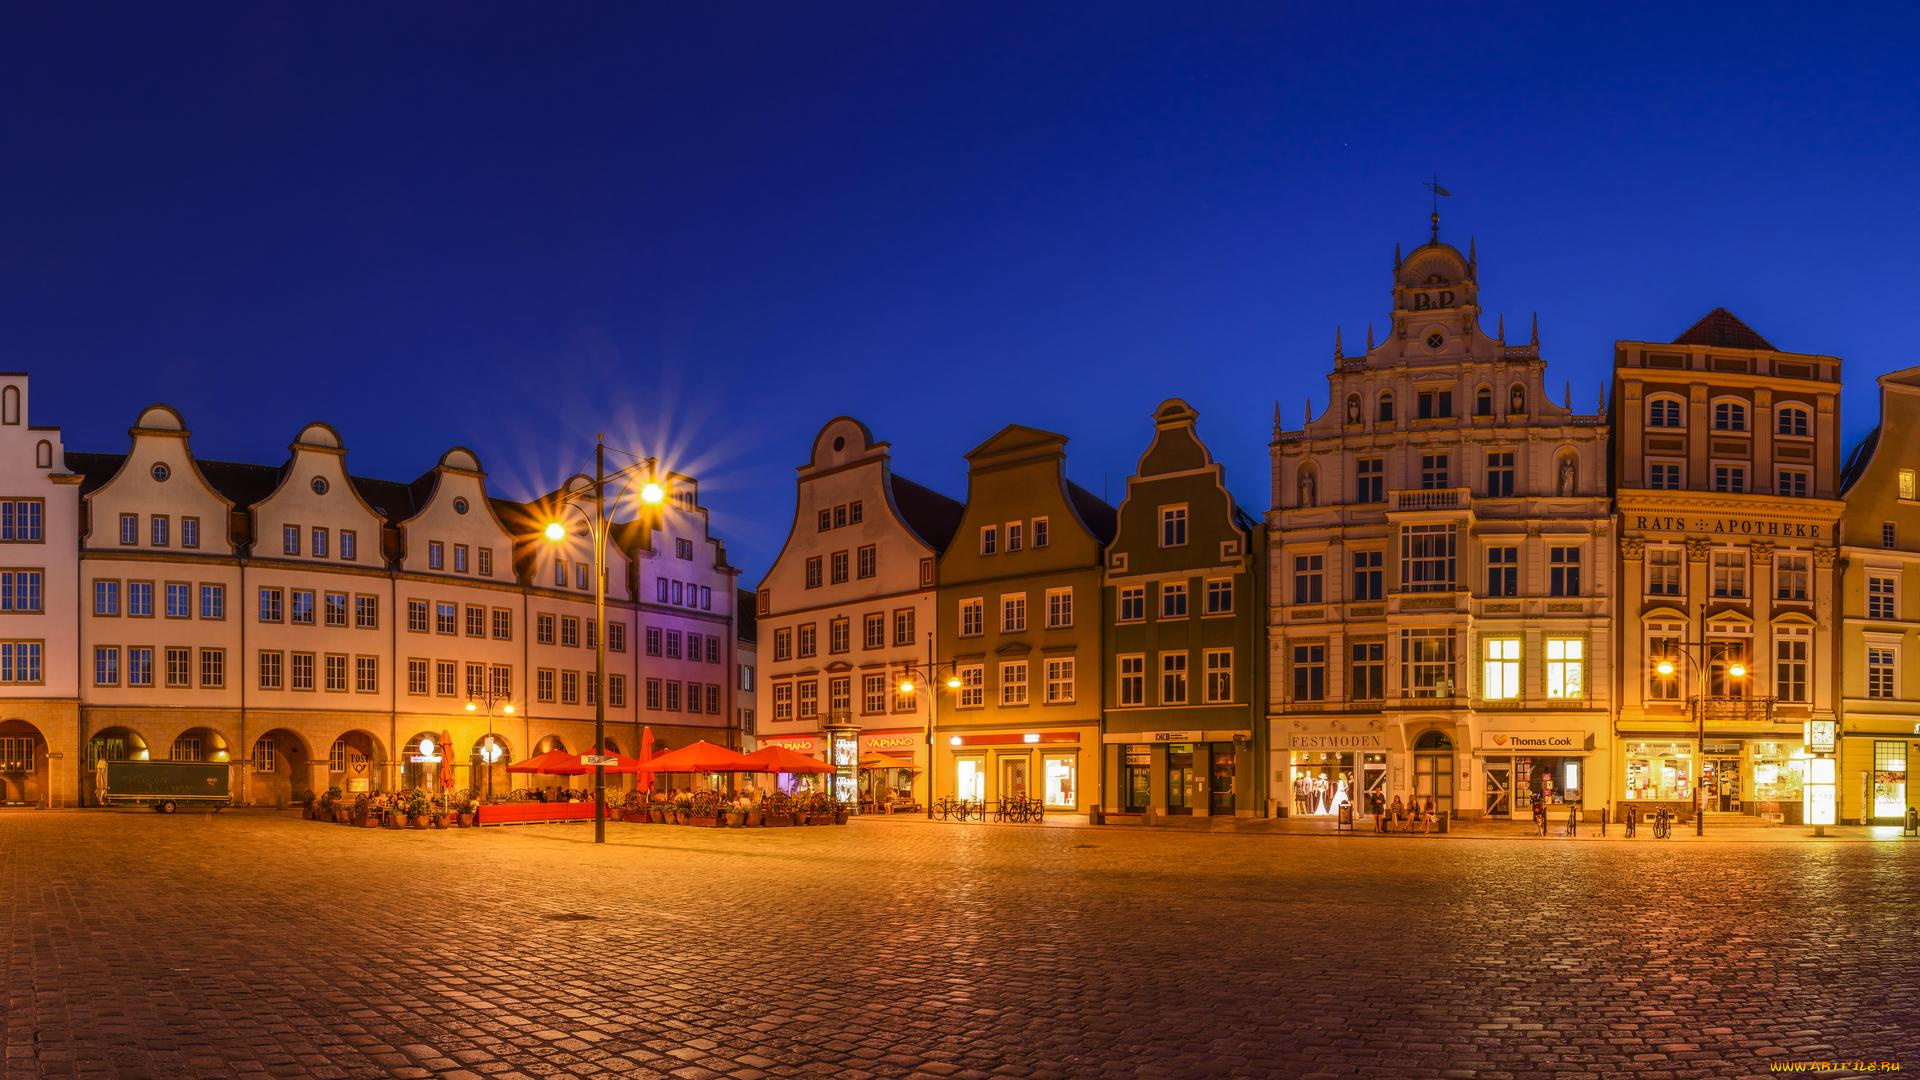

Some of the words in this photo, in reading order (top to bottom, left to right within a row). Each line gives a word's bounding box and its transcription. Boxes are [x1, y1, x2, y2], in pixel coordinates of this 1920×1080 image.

[1637, 516, 1685, 530] RATS
[1714, 519, 1820, 537] APOTHEKE
[867, 738, 913, 749] VAPIANO
[1292, 736, 1381, 747] FESTMODEN
[1510, 737, 1547, 746] Thomas
[1548, 737, 1572, 746] Cook
[351, 754, 369, 763] POST
